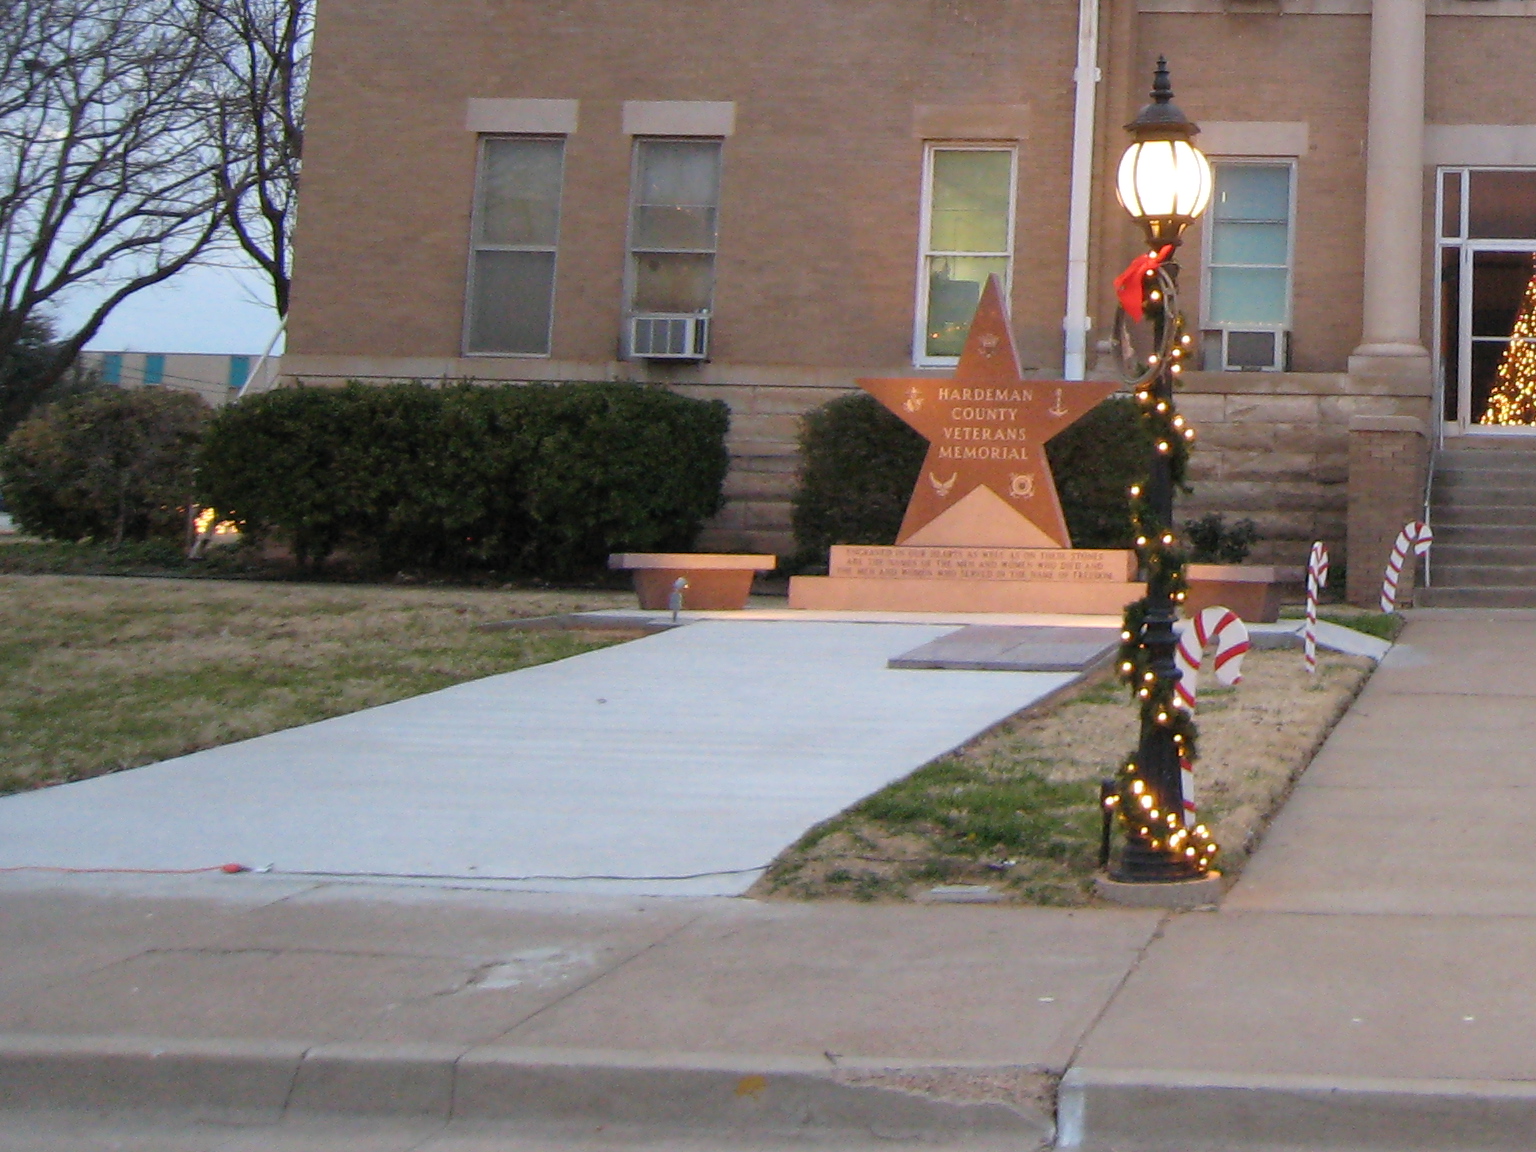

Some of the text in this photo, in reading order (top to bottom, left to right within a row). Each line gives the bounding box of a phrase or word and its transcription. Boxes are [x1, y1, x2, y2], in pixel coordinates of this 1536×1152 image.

[938, 387, 1033, 402] HARDEMAN
[951, 407, 1018, 421] COUNTY
[943, 426, 1027, 441] VETERANS
[938, 446, 1028, 460] MEMORIAL
